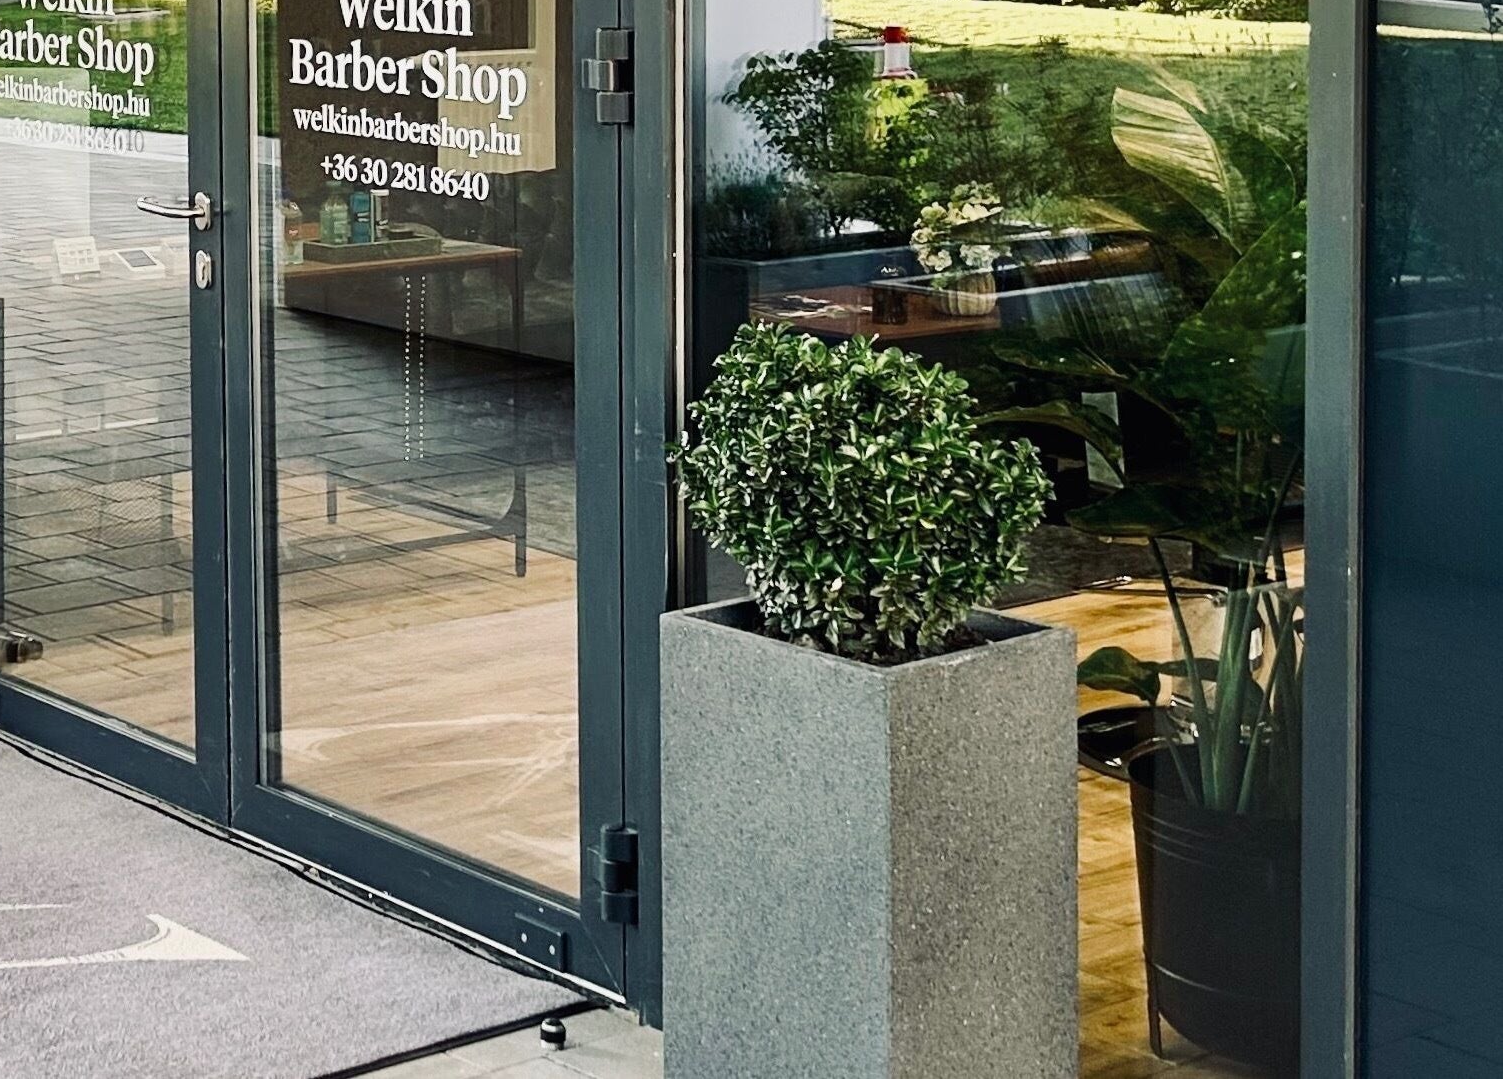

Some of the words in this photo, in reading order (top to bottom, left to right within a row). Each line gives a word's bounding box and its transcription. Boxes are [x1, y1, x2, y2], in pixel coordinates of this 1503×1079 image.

[77, 25, 154, 87] Shop
[289, 38, 415, 95] Barber
[421, 47, 527, 120] Shop
[293, 104, 522, 158] welkinbarbershop.hu
[320, 153, 358, 182] +36
[360, 157, 388, 187] 30
[391, 161, 427, 193] 281
[430, 168, 490, 201] 8640
